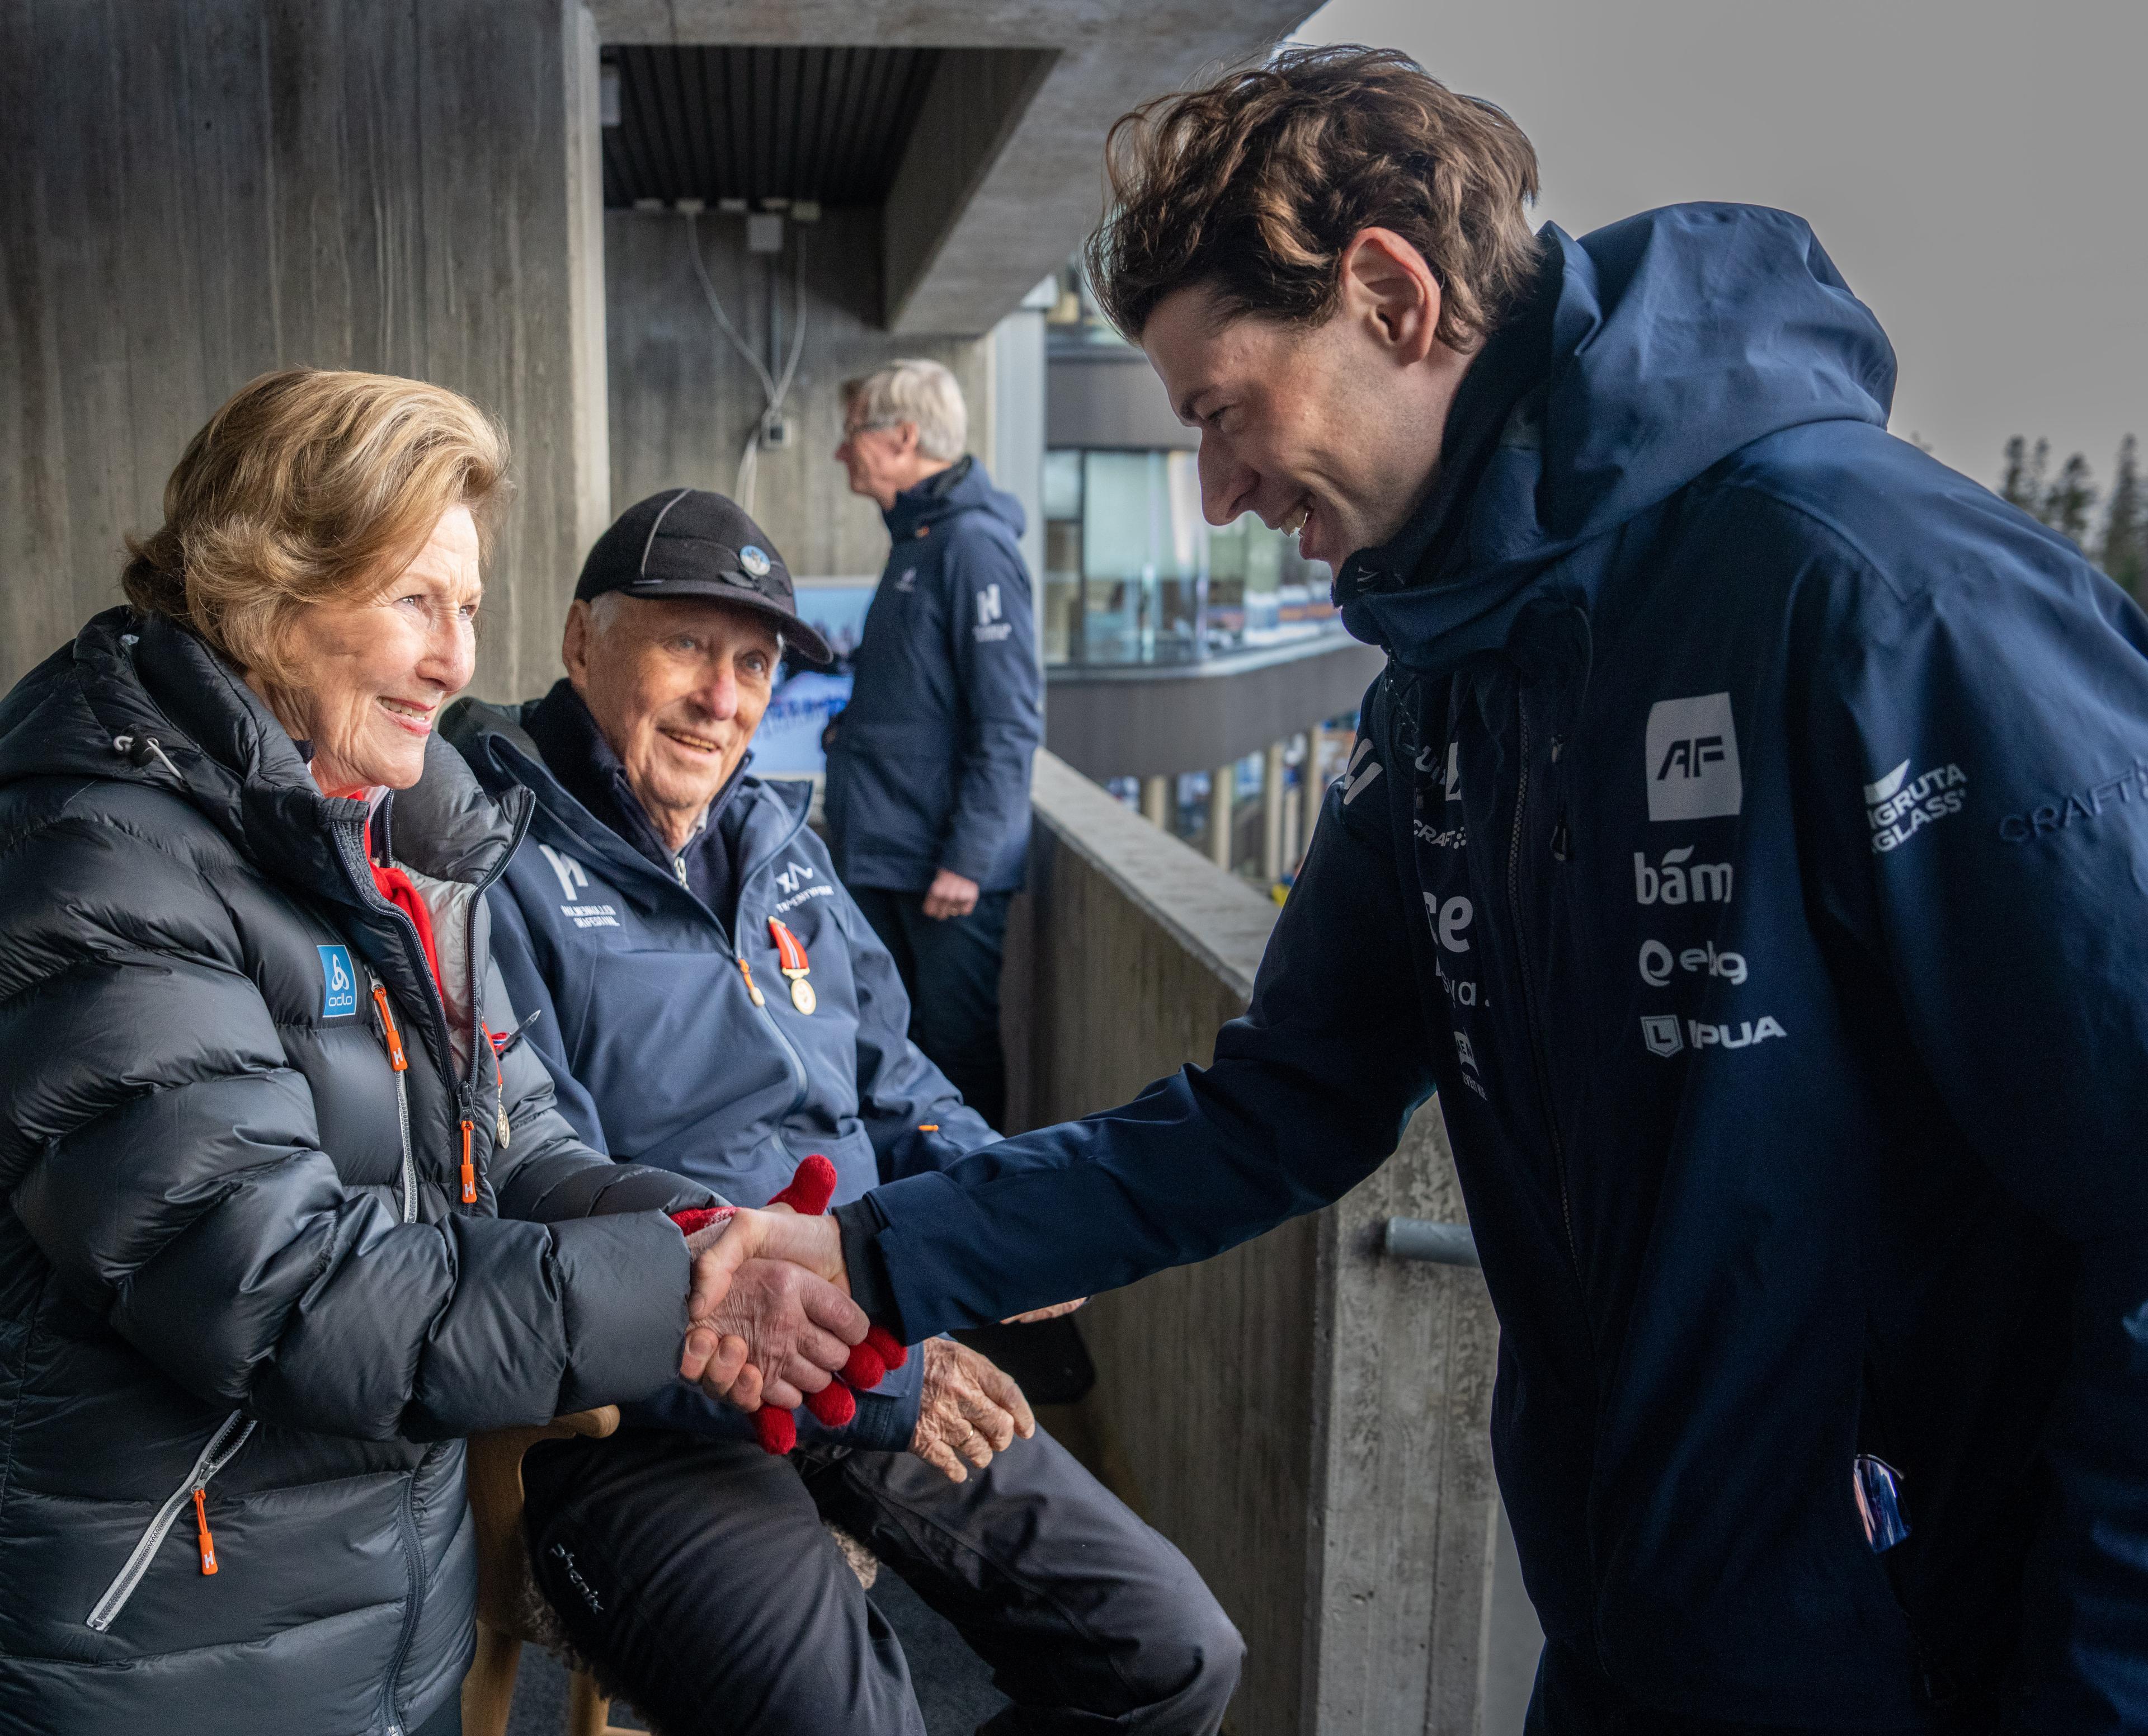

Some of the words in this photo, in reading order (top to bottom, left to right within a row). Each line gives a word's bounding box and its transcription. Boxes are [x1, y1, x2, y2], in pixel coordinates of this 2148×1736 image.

[1657, 736, 1724, 780] AF
[1999, 771, 2134, 843] CRAFT
[328, 995, 352, 1007] odlo
[393, 1047, 403, 1066] H
[464, 1181, 474, 1198] H
[204, 1550, 214, 1569] H
